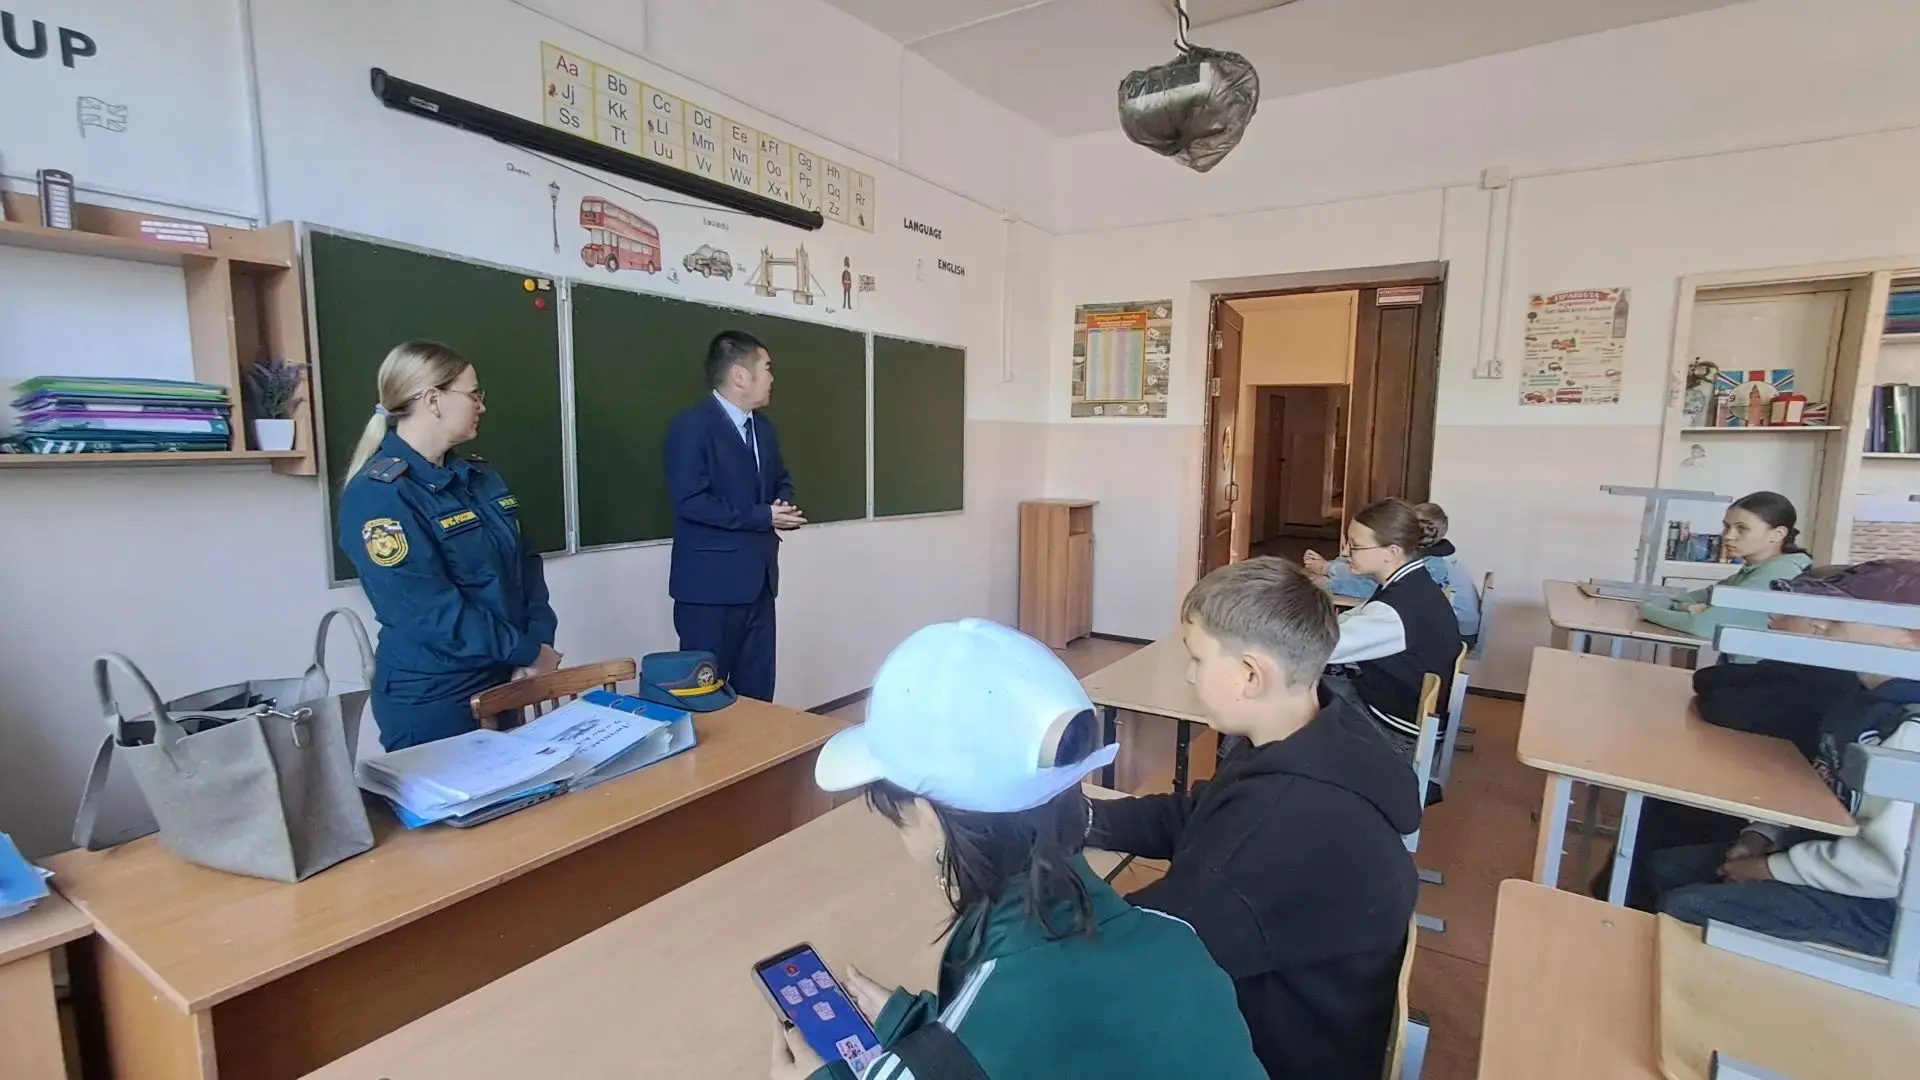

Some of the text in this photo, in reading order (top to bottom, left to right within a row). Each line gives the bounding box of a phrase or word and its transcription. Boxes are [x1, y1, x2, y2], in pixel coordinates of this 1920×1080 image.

[1, 8, 96, 68] UP
[556, 55, 579, 78] Aa
[607, 74, 628, 97] Bb
[652, 94, 673, 114] Cc
[693, 110, 712, 130] Dd
[732, 126, 748, 143] Ee
[768, 140, 780, 156] Ff
[799, 153, 813, 172] Gg
[827, 163, 841, 180] Hh
[563, 85, 576, 106] Jj
[607, 101, 628, 122] Kk
[692, 132, 715, 154] Mm
[731, 147, 749, 166] Nn
[766, 160, 782, 178] Oo
[799, 173, 813, 190] Pp
[827, 183, 841, 201] Qq
[856, 193, 865, 206] Rr
[560, 108, 841, 216] Ss Tt Uu Vv Ww Xx Yy Zz
[904, 217, 942, 239] LANGUAGE
[938, 259, 965, 276] ENGLISH
